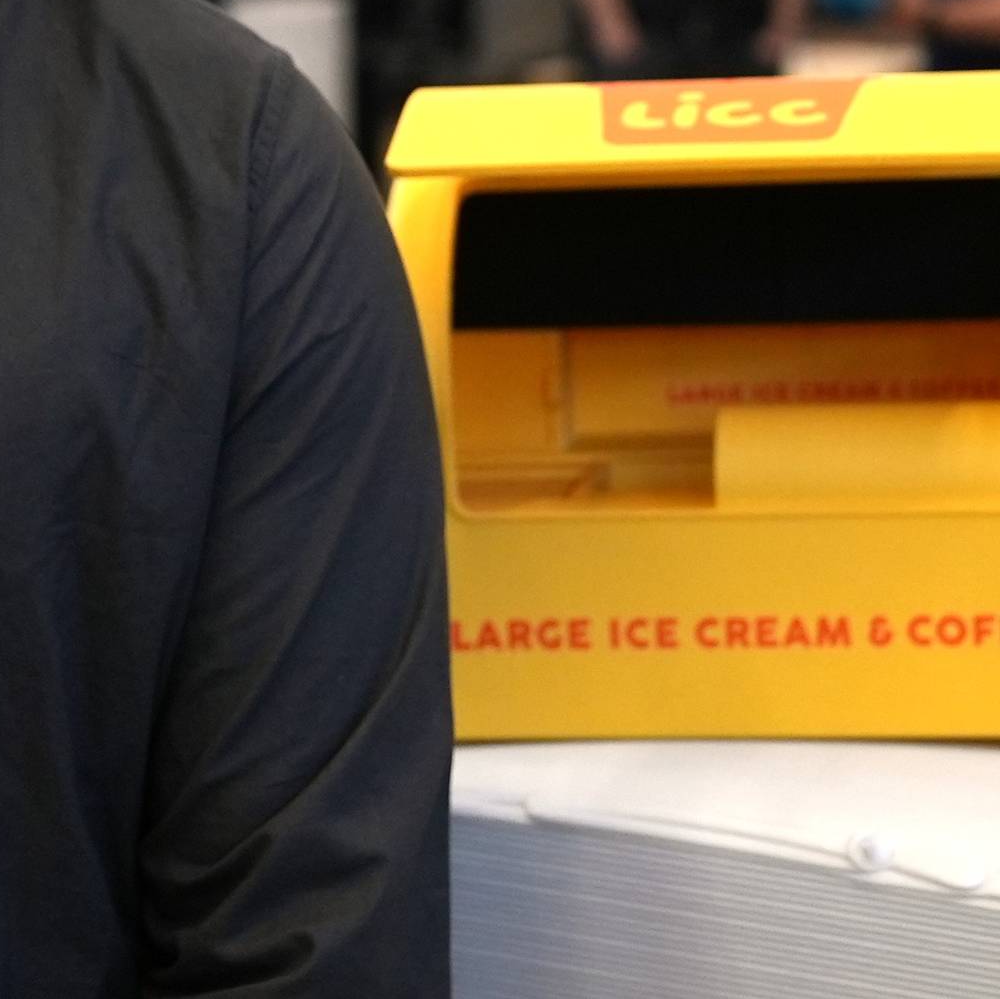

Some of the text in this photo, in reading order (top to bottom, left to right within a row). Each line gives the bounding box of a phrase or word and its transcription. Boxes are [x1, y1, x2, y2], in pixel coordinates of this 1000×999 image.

[451, 617, 592, 651] LARGE
[608, 616, 681, 649] ICE
[694, 615, 854, 649] CREAM
[867, 614, 896, 648] &
